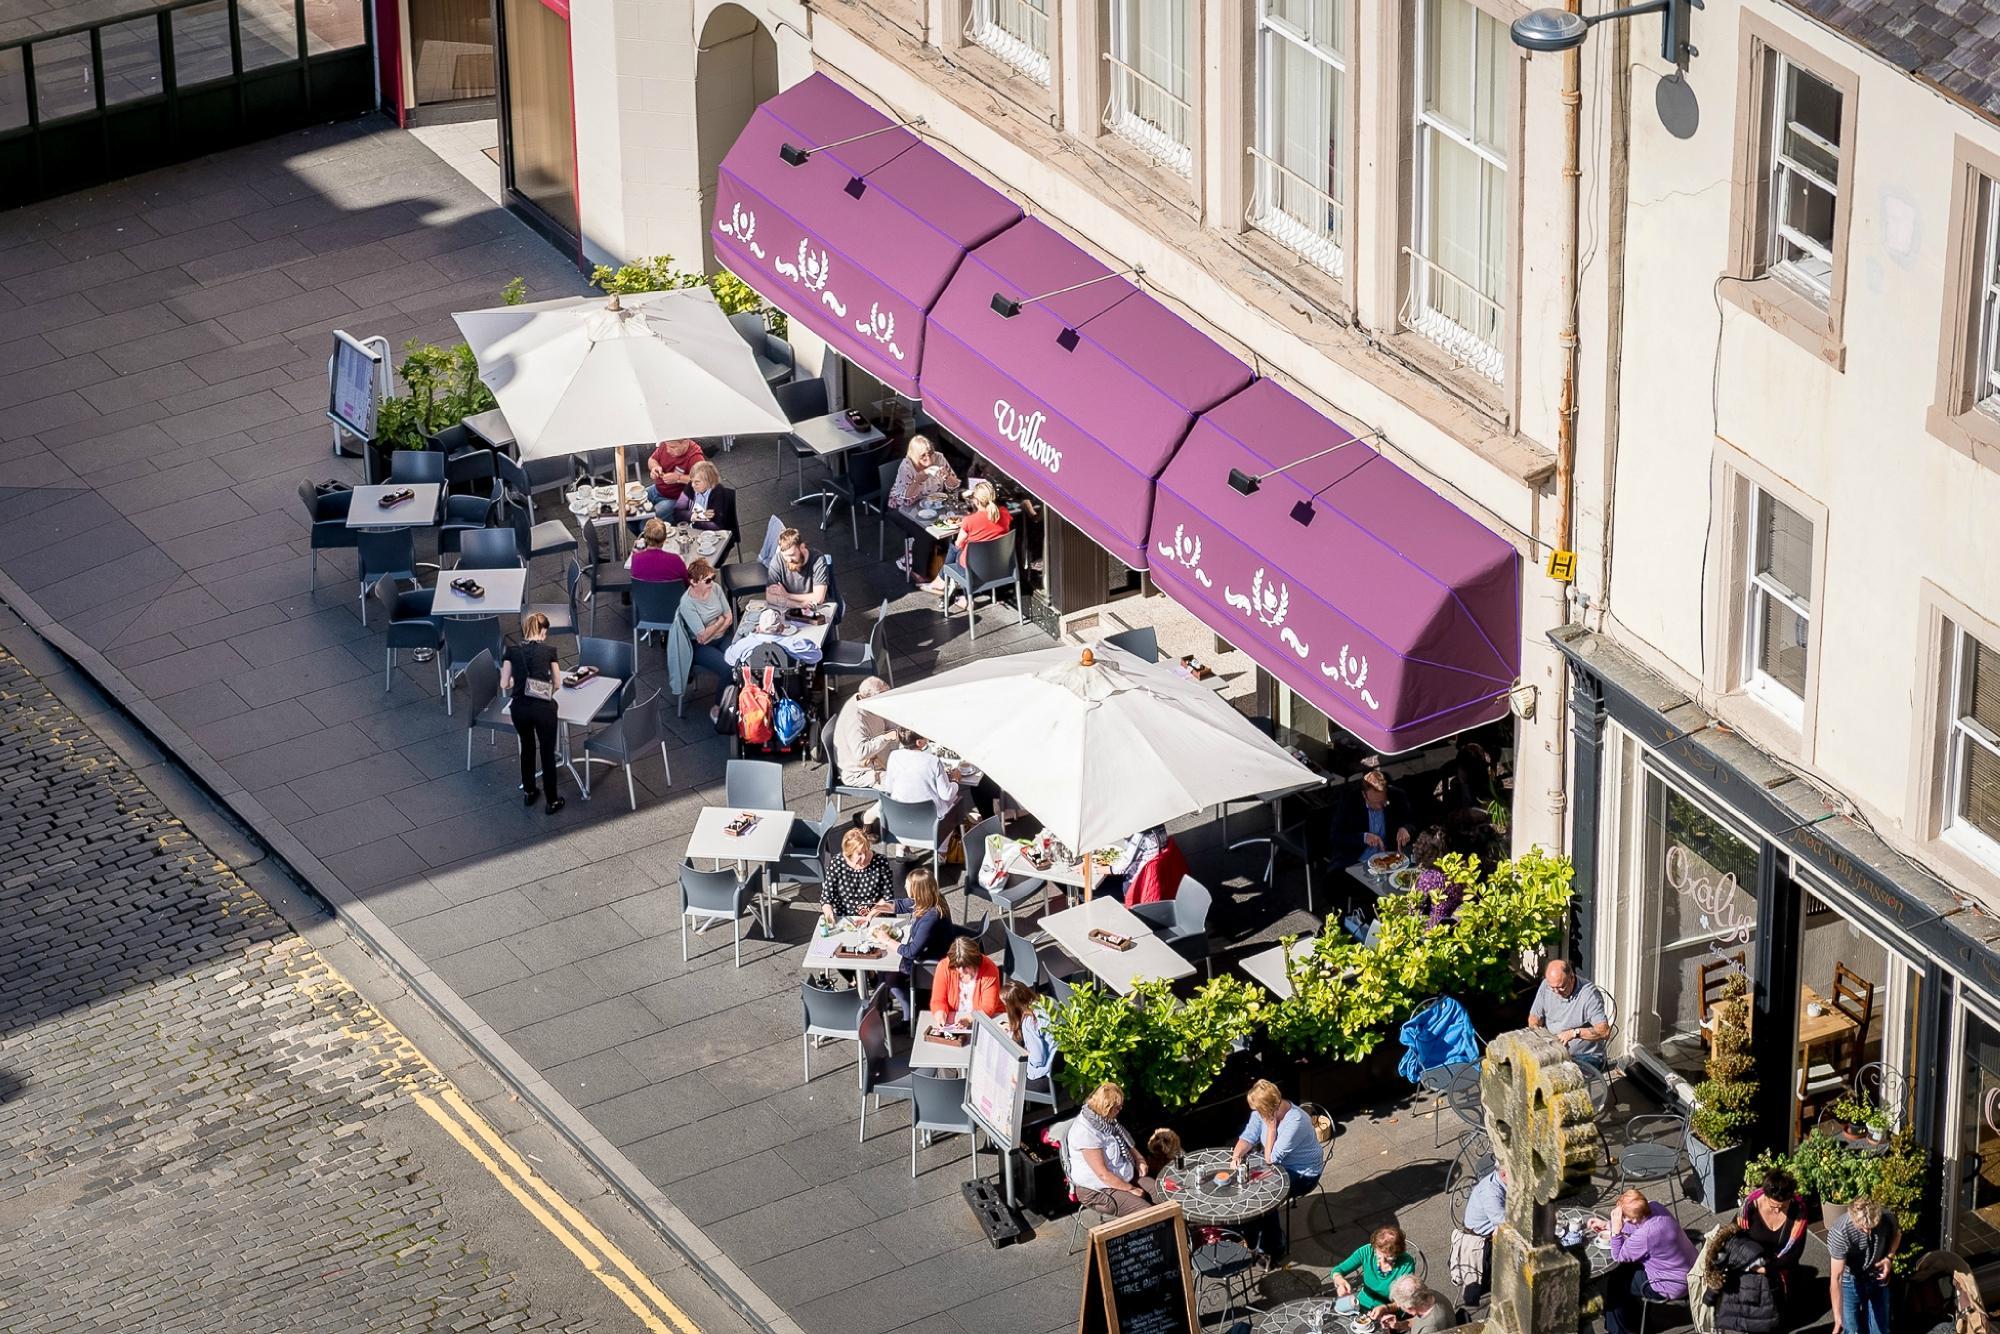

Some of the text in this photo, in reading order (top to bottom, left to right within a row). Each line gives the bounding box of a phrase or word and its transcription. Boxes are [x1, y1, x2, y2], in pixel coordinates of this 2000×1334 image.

[993, 399, 1063, 473] Willows
[1551, 553, 1572, 577] H
[1852, 872, 1904, 922] passion
